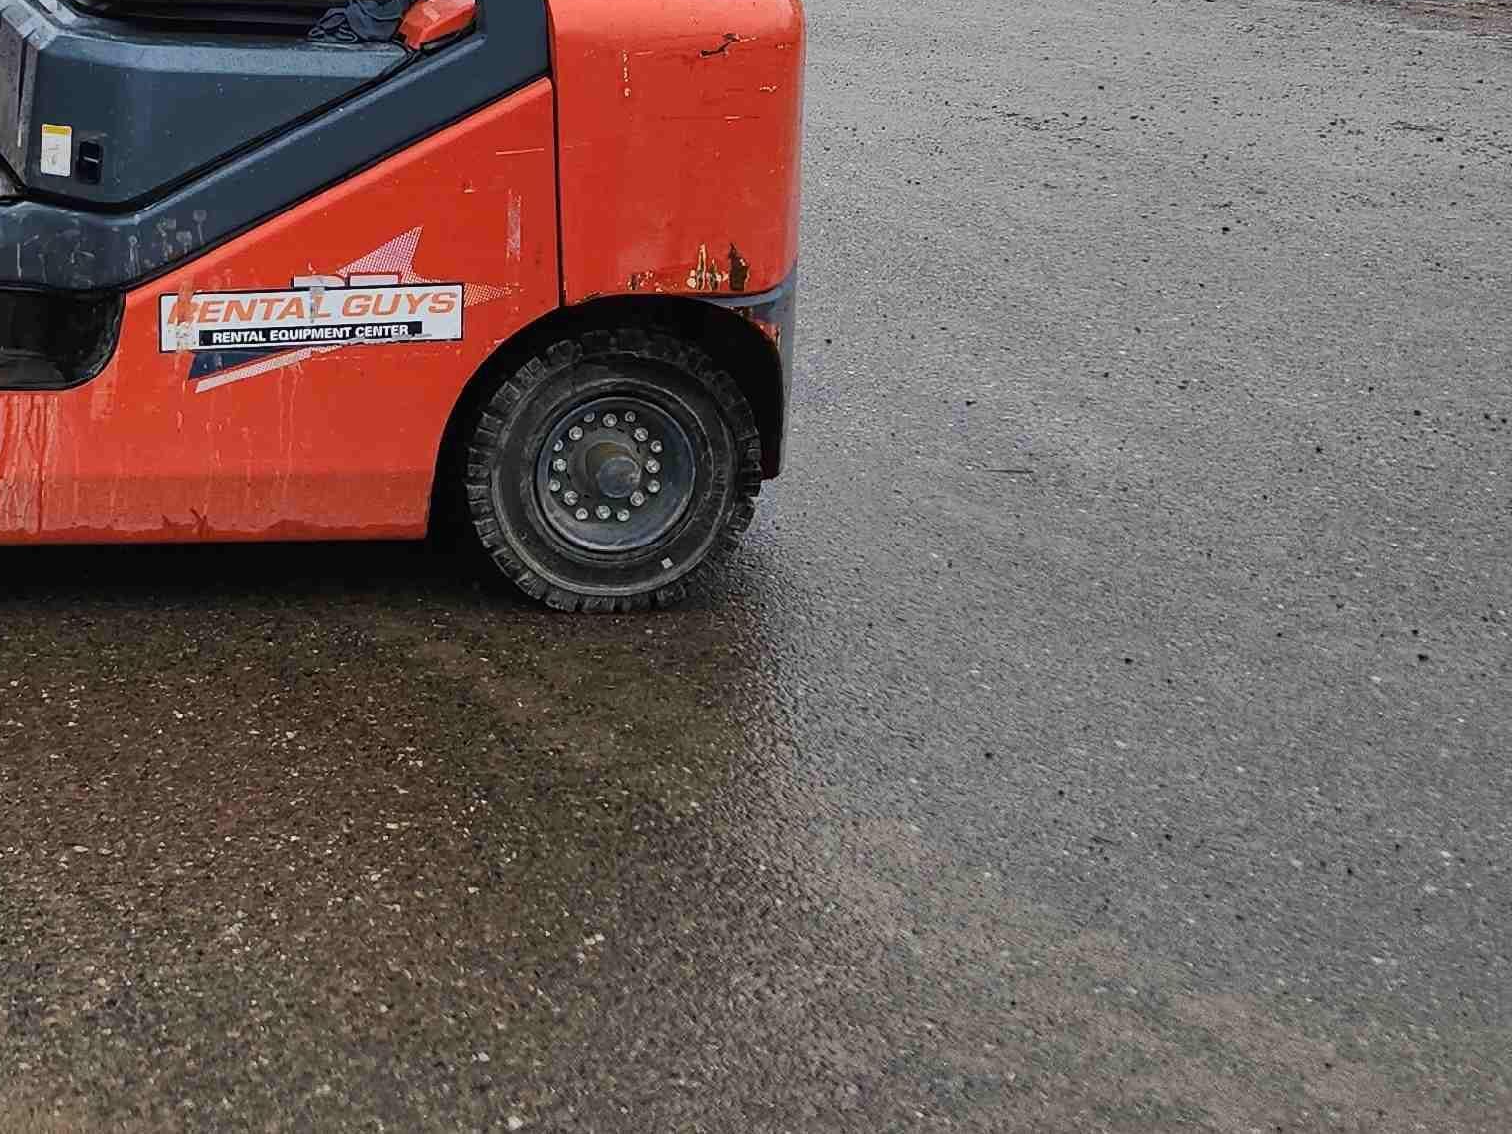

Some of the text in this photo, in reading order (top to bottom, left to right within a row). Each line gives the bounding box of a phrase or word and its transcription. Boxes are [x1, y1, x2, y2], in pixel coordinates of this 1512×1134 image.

[168, 292, 457, 323] RENTAL GUYS
[212, 325, 408, 343] RENTAL EQUIPMENT CENTER
